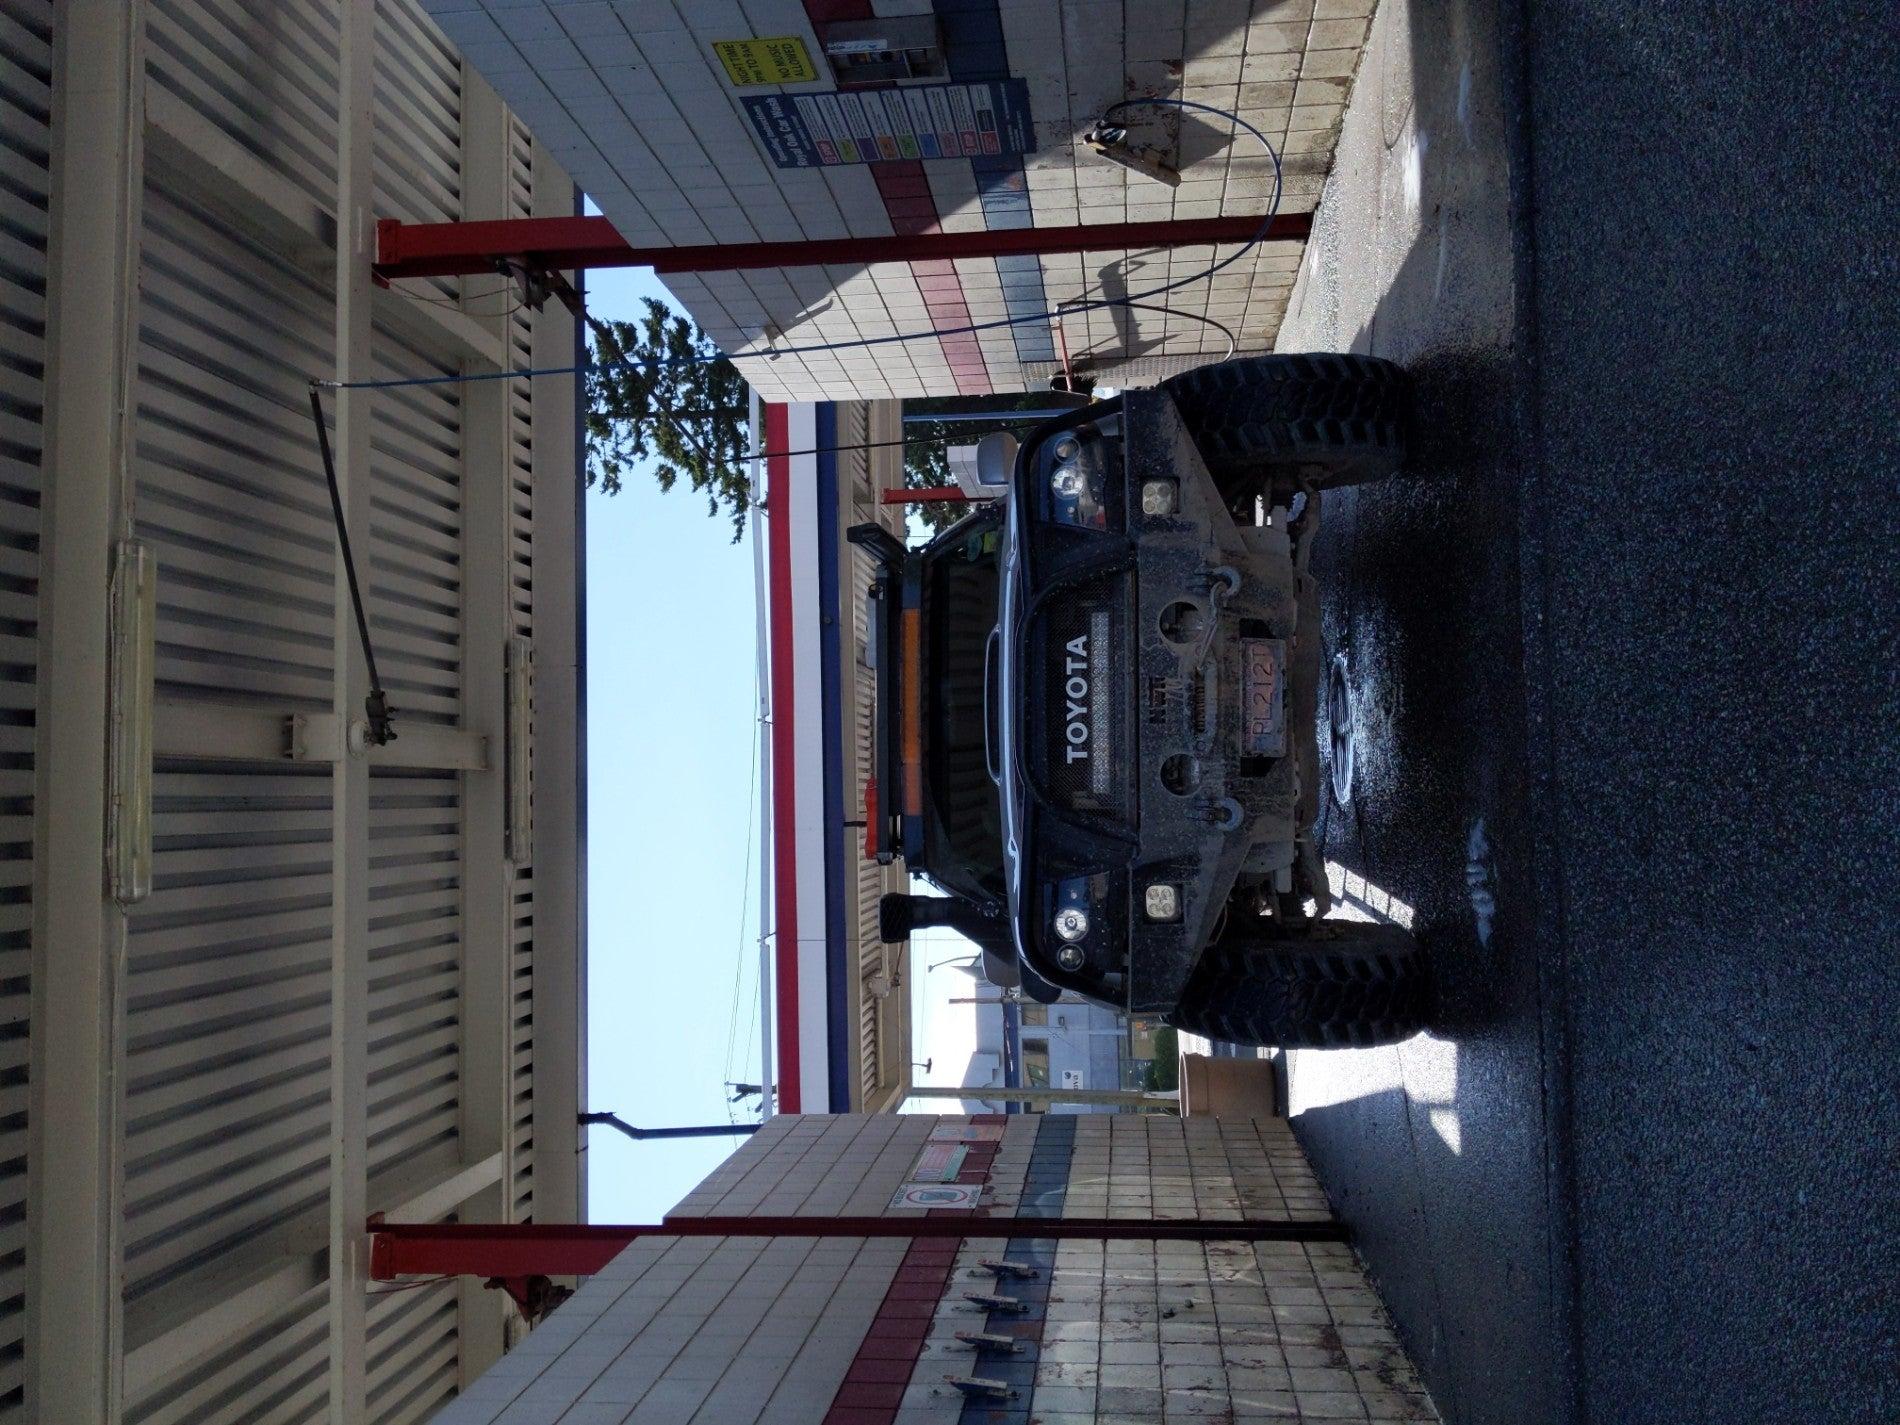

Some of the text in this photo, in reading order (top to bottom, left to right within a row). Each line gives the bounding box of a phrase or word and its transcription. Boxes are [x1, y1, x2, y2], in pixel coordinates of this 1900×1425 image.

[722, 44, 752, 84] NIGHT TIME
[745, 59, 760, 68] TO
[766, 44, 791, 78] NO MUSIC
[782, 44, 806, 77] ALLOWED
[765, 97, 784, 118] Wash
[778, 120, 791, 132] Car
[784, 133, 798, 147] Oak
[789, 148, 808, 166] Royal
[1066, 634, 1088, 764] TOYOTA
[1252, 648, 1273, 735] PL212T
